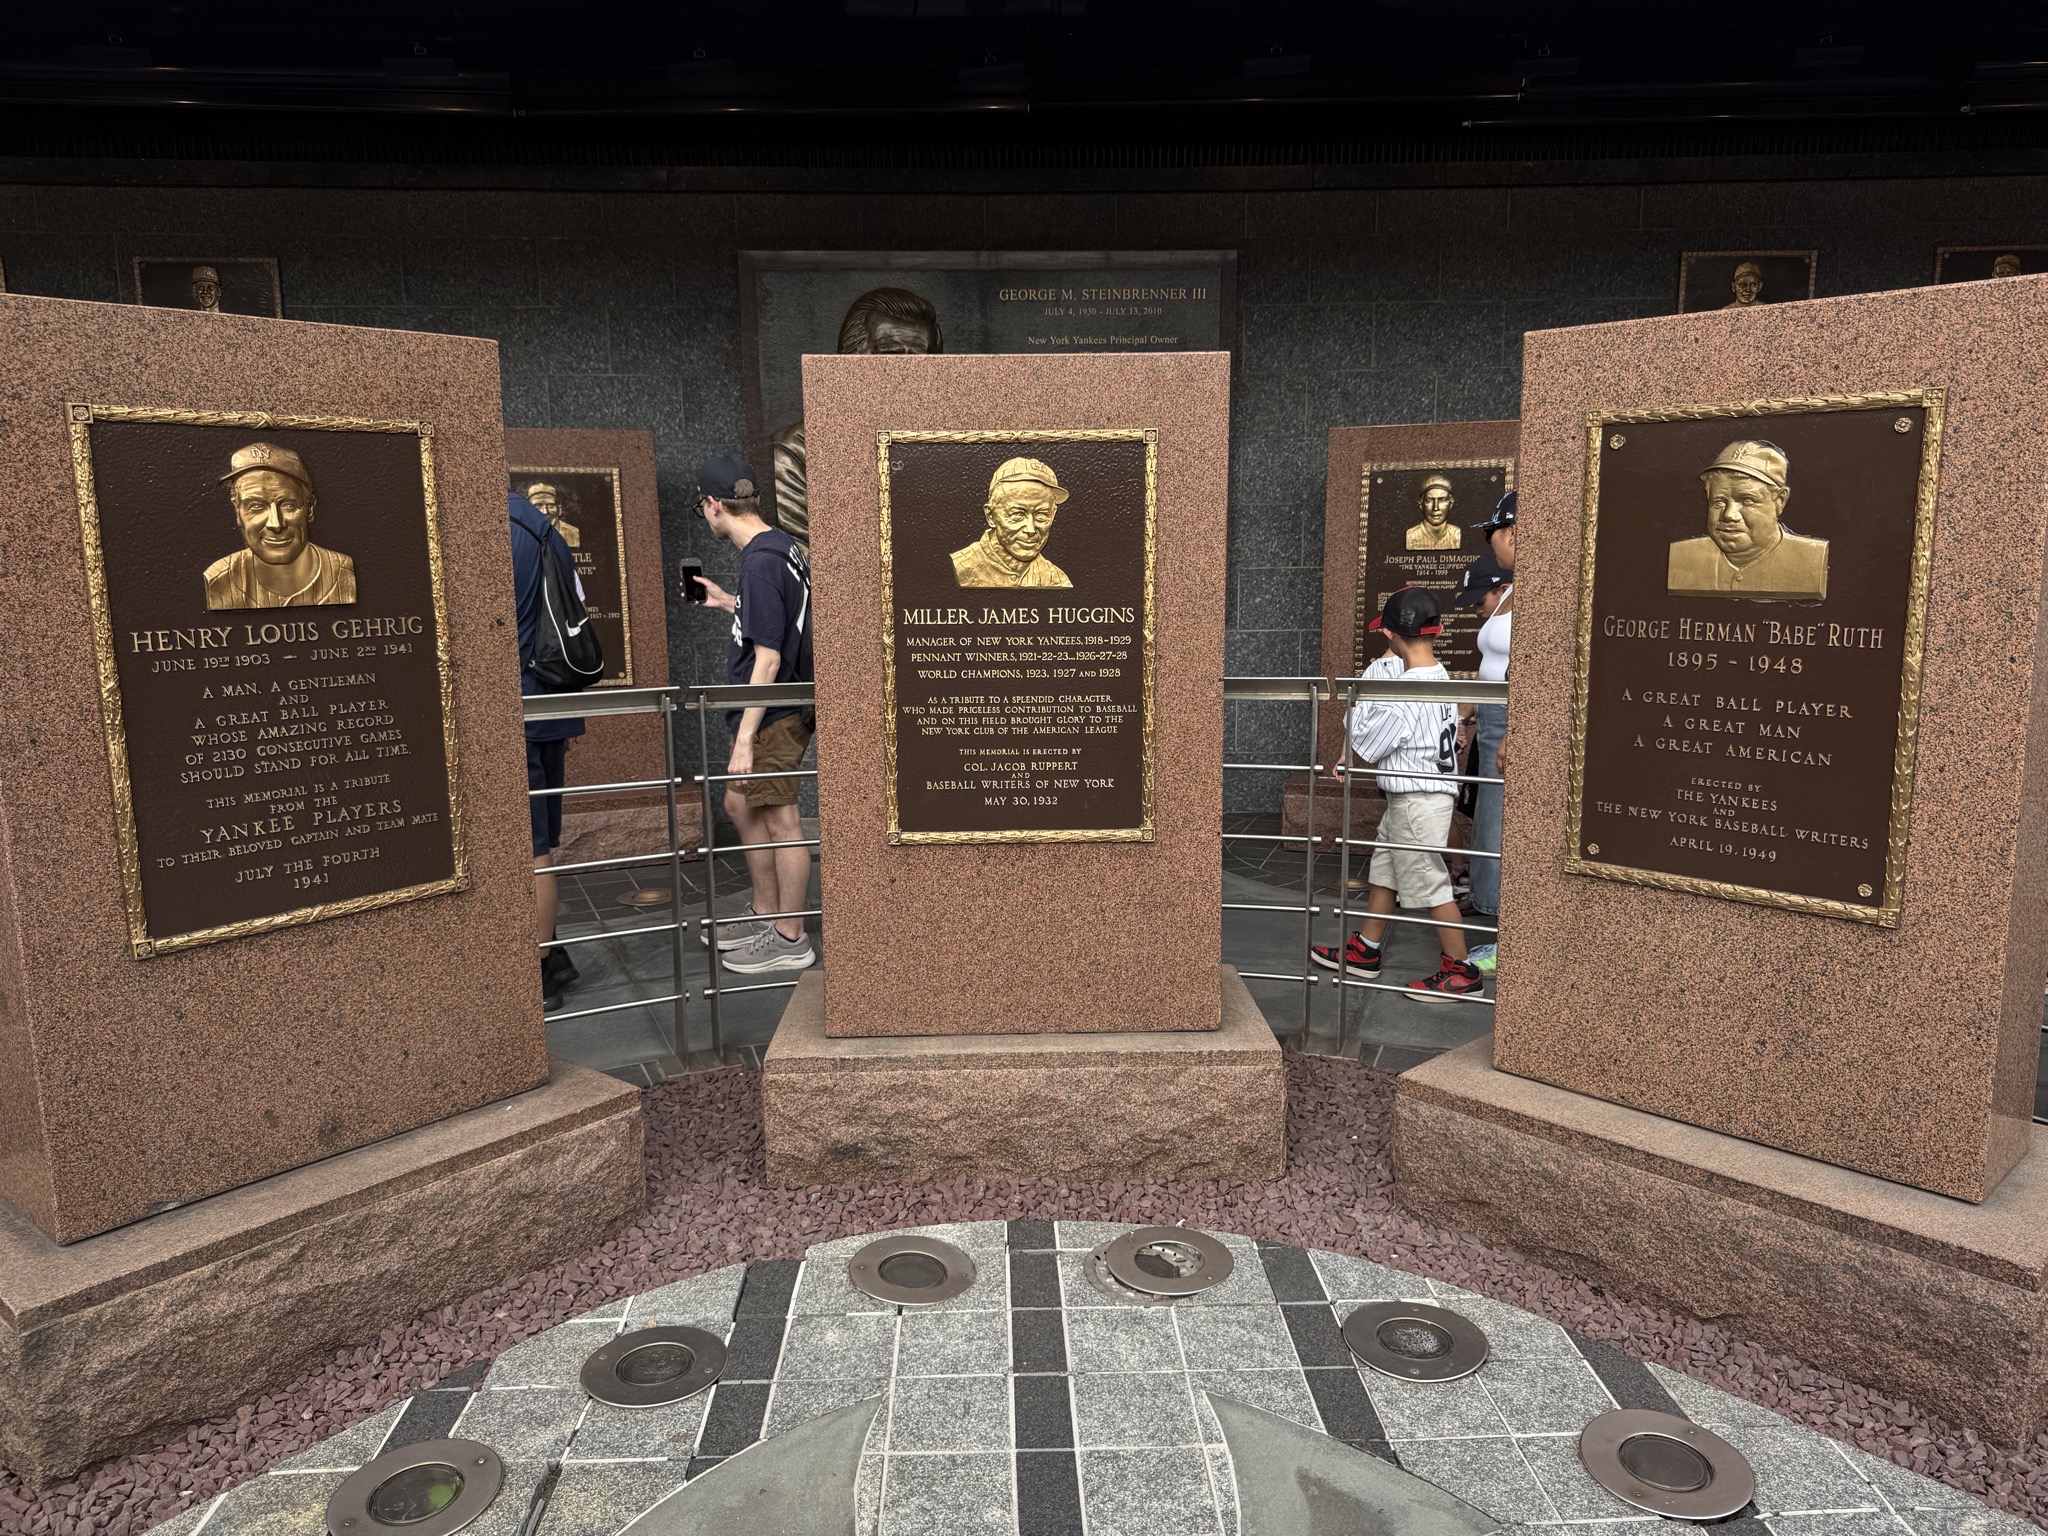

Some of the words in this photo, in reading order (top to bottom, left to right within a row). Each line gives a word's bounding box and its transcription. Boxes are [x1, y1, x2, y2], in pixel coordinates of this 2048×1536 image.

[1000, 289, 1056, 301] GEORGE
[1061, 289, 1077, 300] M.
[1081, 288, 1187, 300] STEINBRENNER
[1192, 287, 1207, 300] III
[1044, 308, 1065, 316] JULY
[1105, 308, 1127, 316] JULY
[1143, 307, 1162, 315] 2010
[1028, 336, 1047, 345] New
[1050, 336, 1070, 345] York
[1073, 336, 1107, 345] Yankees
[1110, 335, 1148, 346] Principal
[1150, 335, 1178, 344] Owner
[1384, 555, 1415, 564] JOSEPH
[1416, 555, 1437, 563] PAUL
[903, 608, 974, 625] MILLER
[979, 608, 1039, 624] JAMES
[1048, 607, 1135, 624] HUGGINS
[130, 626, 233, 653] HENRY
[245, 622, 319, 646] LOUIS
[332, 616, 423, 639] GEHRIG
[907, 637, 957, 646] MANAGER
[960, 637, 972, 646] OF
[977, 637, 1001, 646] NEW
[1006, 637, 1034, 646] YORK
[1603, 615, 1670, 640] GEORGE
[1678, 617, 1756, 644] HERMAN
[1827, 623, 1884, 650] RUTH
[152, 659, 196, 673] JUNE
[235, 654, 271, 667] 1903
[311, 648, 349, 661] JUNE
[384, 643, 413, 655] 1941
[911, 653, 961, 662] PENNANT
[1668, 651, 1718, 671] 1895
[1749, 655, 1803, 675] 1948
[918, 670, 957, 679] WORLD
[961, 669, 1023, 679] CHAMPIONS,
[1053, 669, 1076, 678] 1927
[1079, 670, 1096, 678] AND
[1099, 668, 1121, 677] 1928
[203, 686, 214, 699] A
[271, 680, 281, 693] A
[288, 673, 376, 691] GENTLEMAN
[279, 694, 309, 705] AND
[949, 696, 985, 704] TRIBUTE
[1059, 695, 1112, 703] CHARACTER
[1621, 688, 1632, 701] A
[1642, 691, 1701, 707] GREAT
[1715, 696, 1763, 712] BALL
[1775, 701, 1853, 719] PLAYER
[194, 717, 206, 730] A
[216, 710, 269, 727] GREAT
[280, 706, 319, 720] BALL
[329, 699, 389, 715] PLAYER
[929, 706, 953, 714] MADE
[959, 706, 1000, 714] PRICELESS
[1079, 705, 1091, 713] TO
[1096, 705, 1137, 713] BASEBALL
[942, 717, 955, 725] ON
[959, 717, 978, 725] THIS
[982, 717, 1007, 725] FIELD
[1010, 716, 1052, 724] BROUGHT
[1056, 716, 1085, 724] GLORY
[1105, 715, 1123, 723] THE
[1662, 714, 1673, 728] A
[1684, 717, 1745, 735] GREAT
[1758, 723, 1802, 740] MAN
[191, 730, 248, 746] WHOSE
[257, 722, 327, 740] AMAZING
[337, 714, 394, 731] RECORD
[921, 727, 943, 735] NEW
[946, 727, 970, 735] YORK
[973, 727, 995, 735] CLUB
[1032, 726, 1080, 734] AMERICAN
[1085, 726, 1118, 734] LEAGUE
[185, 753, 204, 766] OF
[213, 748, 247, 763] 2130
[257, 736, 352, 757] CONSECUTIVE
[360, 729, 402, 744] GAMES
[1633, 734, 1644, 748] A
[1655, 737, 1713, 755] GREAT
[1725, 744, 1833, 767] AMERICAN
[180, 765, 245, 784] SHOULD
[254, 758, 301, 774] STAND
[310, 754, 339, 767] FOR
[345, 750, 369, 762] ALL
[964, 763, 988, 772] COL.
[991, 762, 1026, 771] JACOB
[1031, 762, 1078, 771] RUPPERT
[206, 797, 236, 809] THIS
[244, 786, 308, 804] MEMORIAL
[344, 773, 391, 789] TRIBUTE
[926, 781, 976, 790] BASEBALL
[981, 780, 1031, 789] WRITERS
[1035, 780, 1049, 789] OF
[1054, 779, 1080, 789] NEW
[1084, 779, 1115, 788] YORK
[1691, 777, 1742, 790] ERECTED
[1748, 784, 1762, 793] BY
[270, 801, 305, 815] FROM
[314, 796, 338, 807] THE
[984, 797, 1007, 806] MAY
[1012, 797, 1030, 806] 30,
[1033, 796, 1058, 805] 1932
[1676, 788, 1704, 802] THE
[1710, 793, 1778, 811] YANKEES
[1712, 807, 1735, 817] AND
[200, 816, 295, 844] YANKEE
[313, 800, 402, 826] PLAYERS
[1596, 801, 1622, 814] THE
[1628, 806, 1662, 819] NEW
[1668, 811, 1709, 827] YORK
[1715, 818, 1788, 838] BASEBALL
[1795, 828, 1869, 850] WRITERS
[157, 858, 175, 868] TO
[181, 849, 222, 864] THEIR
[228, 839, 282, 856] BELOVED
[291, 829, 339, 845] CAPTAIN
[345, 824, 370, 837] AND
[376, 817, 405, 831] TEAM
[412, 812, 439, 825] MATE
[1670, 835, 1714, 852] APRIL
[1742, 846, 1777, 863] 1949
[235, 866, 274, 883] JULY
[284, 859, 314, 874] THE
[323, 847, 380, 867] FOURTH
[294, 873, 328, 889] 1941
